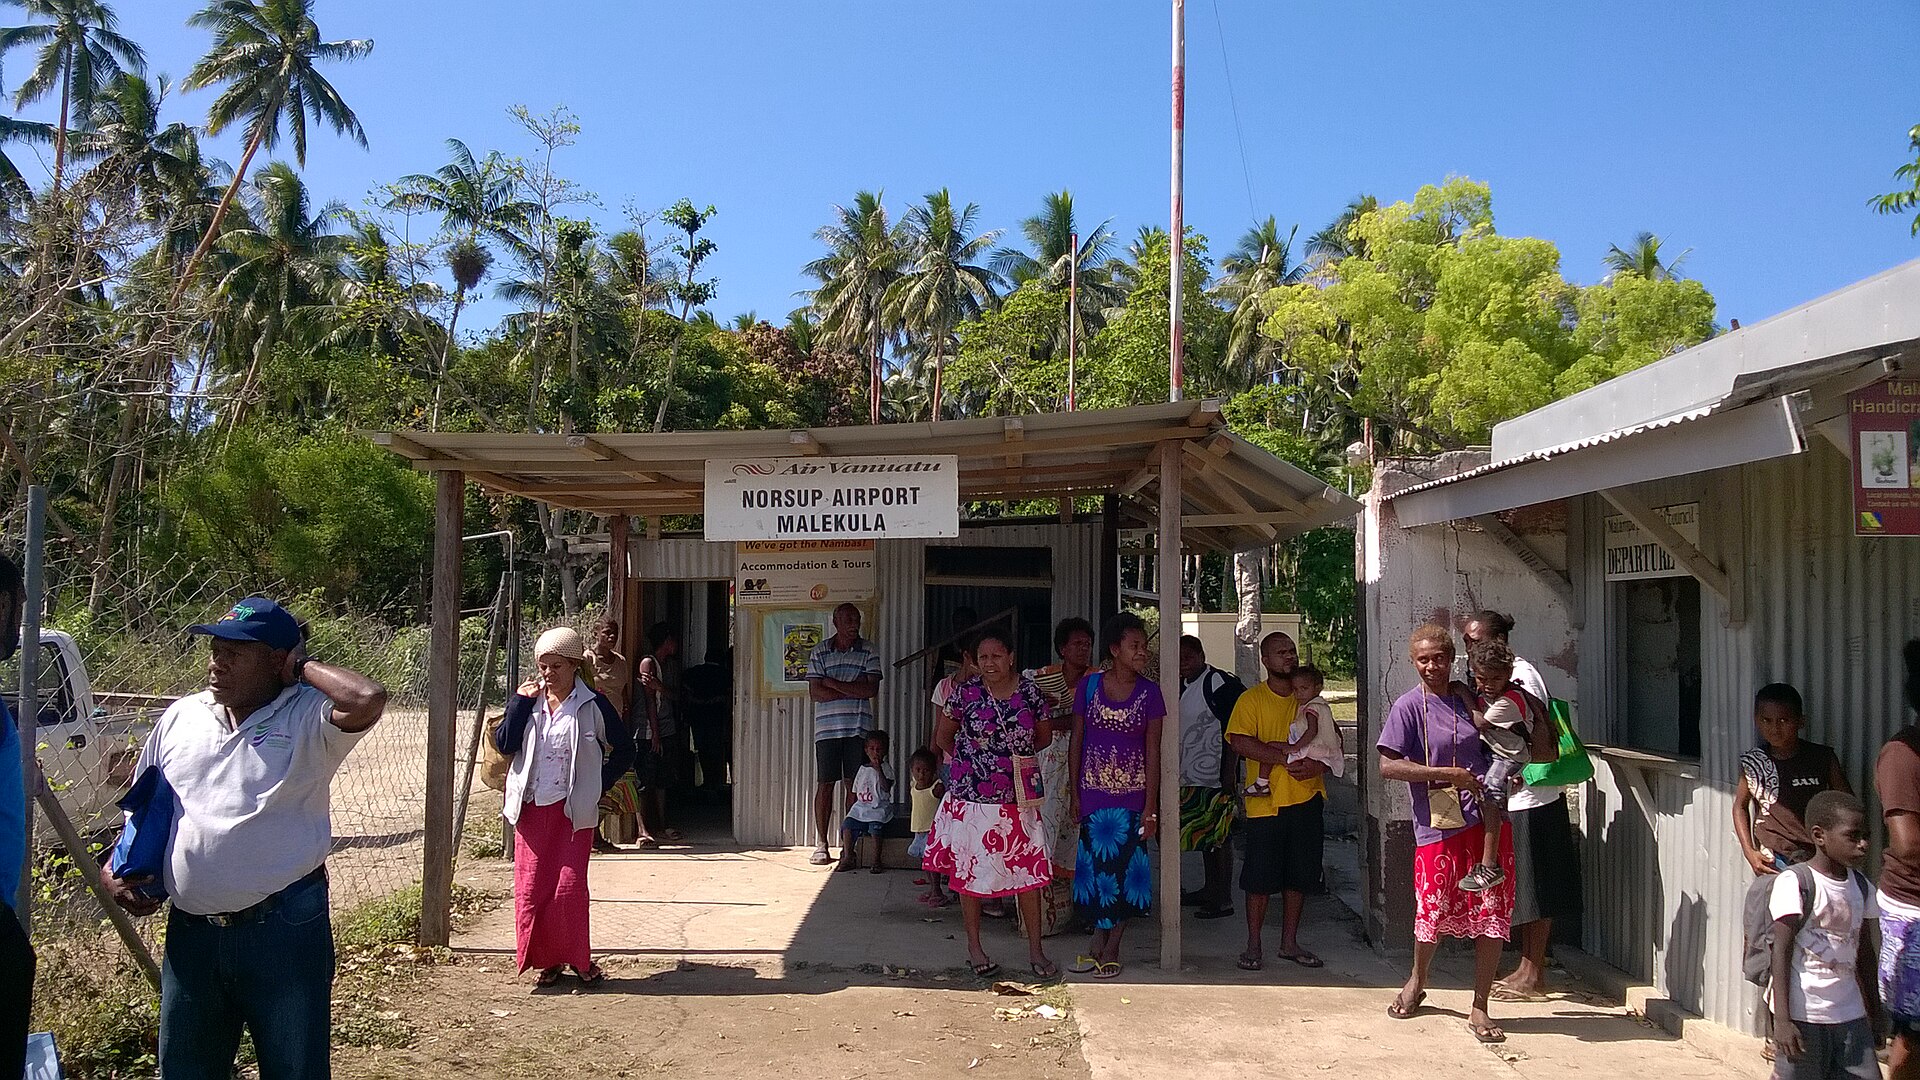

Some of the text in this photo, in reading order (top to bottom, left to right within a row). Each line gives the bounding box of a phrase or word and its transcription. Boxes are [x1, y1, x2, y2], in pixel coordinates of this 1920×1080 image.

[779, 461, 941, 475] Air Vanuatu
[742, 487, 920, 508] NORSUP AIRPORT
[777, 513, 886, 533] MALEKULA
[745, 540, 776, 550] We've
[779, 540, 798, 552] got
[800, 539, 817, 549] the
[740, 560, 871, 571] Accommodation & Tours
